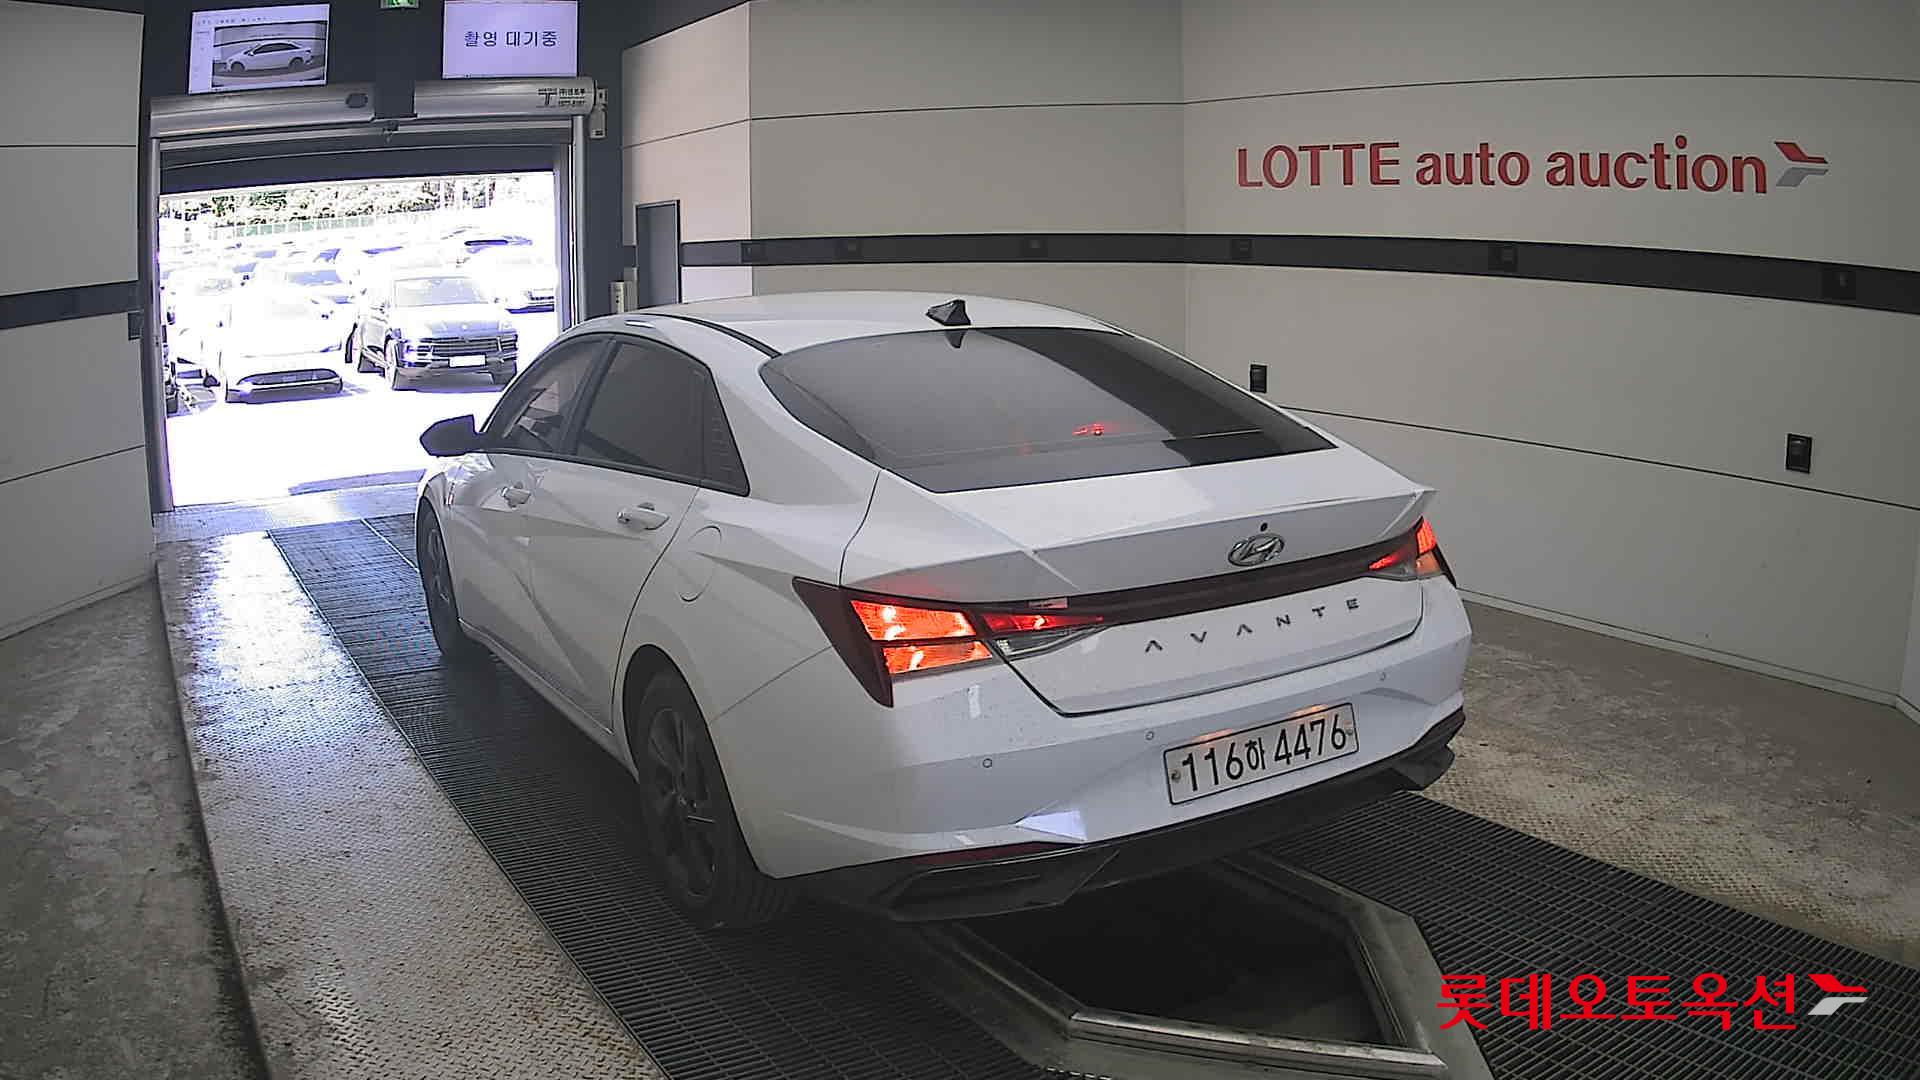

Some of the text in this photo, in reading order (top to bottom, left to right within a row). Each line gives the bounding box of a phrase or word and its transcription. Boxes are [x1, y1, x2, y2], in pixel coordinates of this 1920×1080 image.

[506, 31, 557, 47] 대기중
[1237, 135, 1768, 194] LOTTE auto auction
[1144, 597, 1361, 654] AVANTE
[1273, 713, 1347, 765] 4476
